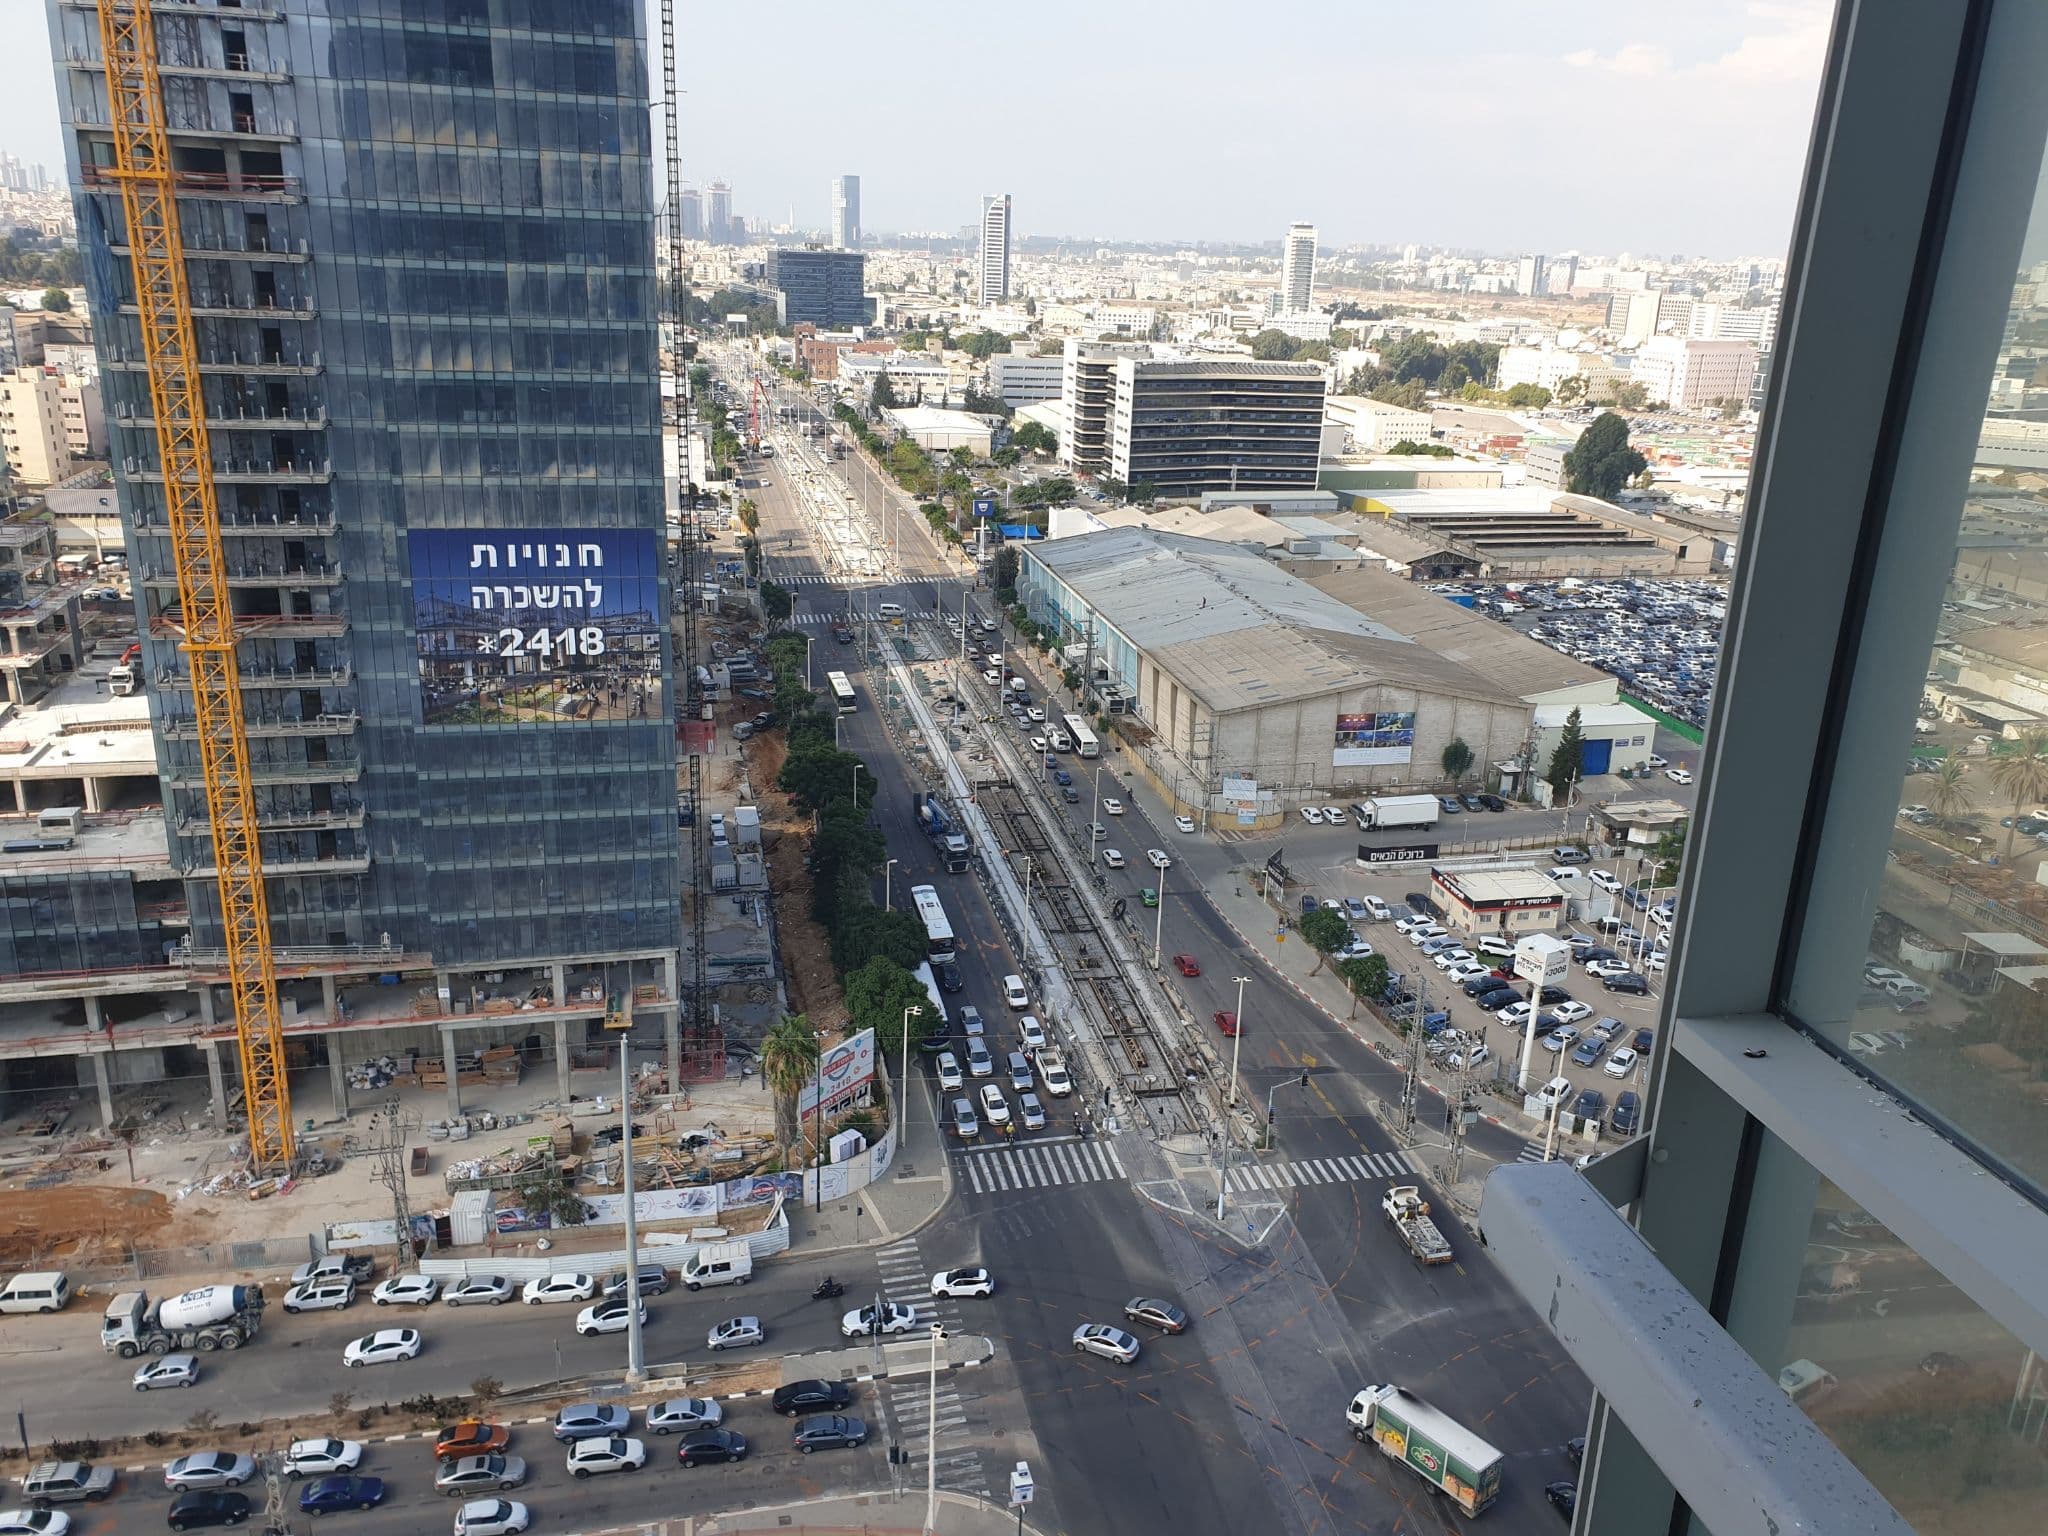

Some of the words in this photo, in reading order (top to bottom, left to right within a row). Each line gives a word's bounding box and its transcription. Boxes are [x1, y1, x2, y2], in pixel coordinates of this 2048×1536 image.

[470, 543, 603, 569] חנויות
[471, 578, 602, 609] להשכרה
[1370, 852, 1396, 861] הבאים
[1398, 850, 1424, 860] ברוכים
